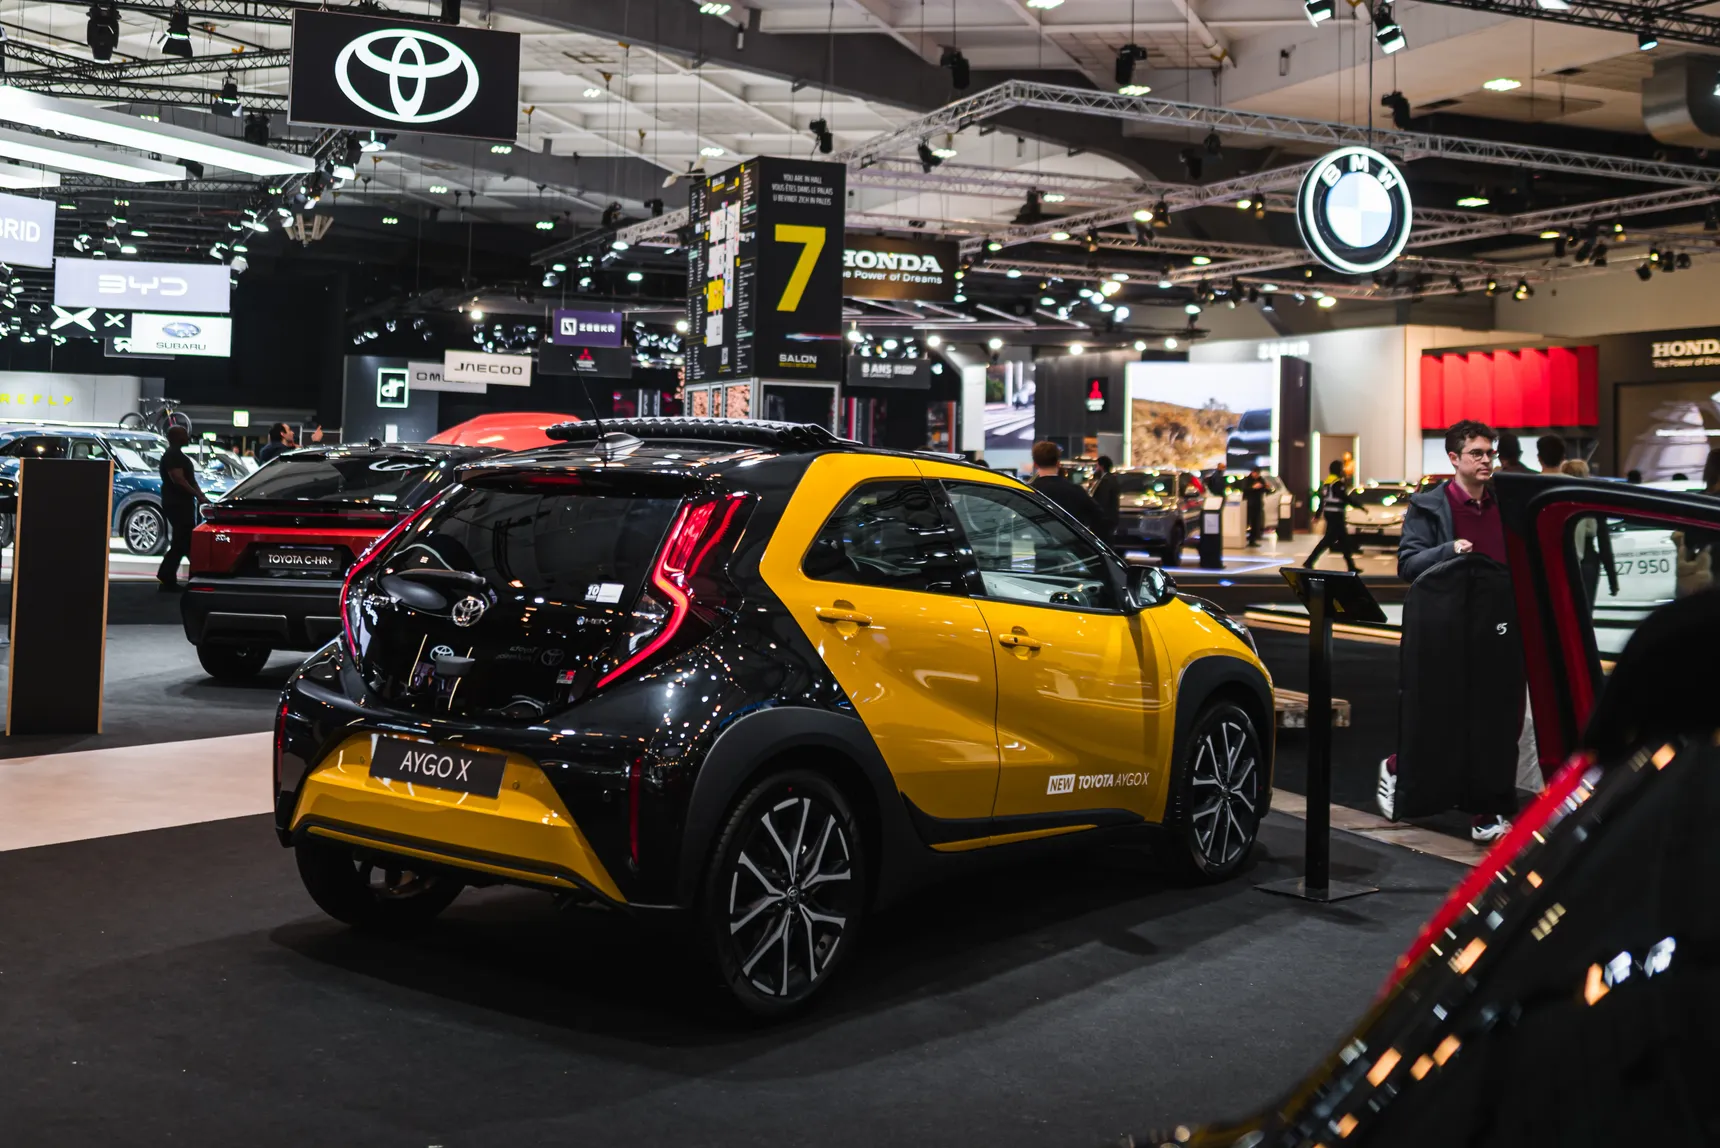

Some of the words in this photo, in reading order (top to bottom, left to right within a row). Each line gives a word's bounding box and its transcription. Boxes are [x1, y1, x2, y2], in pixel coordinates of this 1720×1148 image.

[783, 174, 793, 182] YOU
[794, 174, 803, 182] ARE
[810, 176, 822, 184] HALL
[1321, 155, 1398, 190] BMW
[772, 183, 785, 191] VOUS
[797, 186, 810, 194] DANS
[817, 187, 833, 195] PALAIS
[0, 219, 41, 243] RID
[775, 224, 826, 312] 7
[98, 274, 188, 296] BYD
[854, 270, 886, 280] Power
[889, 271, 900, 281] of
[902, 273, 943, 284] Dreams
[579, 322, 616, 333] ZEEKR
[156, 341, 206, 350] SUBARU
[1652, 339, 1720, 357] HOND
[779, 354, 817, 363] SALON
[268, 554, 303, 564] TOYOTA
[305, 555, 333, 565] C-HR+
[1637, 558, 1670, 575] 950
[399, 751, 454, 778] AYGO
[456, 759, 472, 781] X
[1049, 776, 1073, 792] NEW
[1079, 774, 1114, 789] TOYOTA
[1114, 773, 1142, 787] AYGO
[1142, 772, 1150, 786] X
